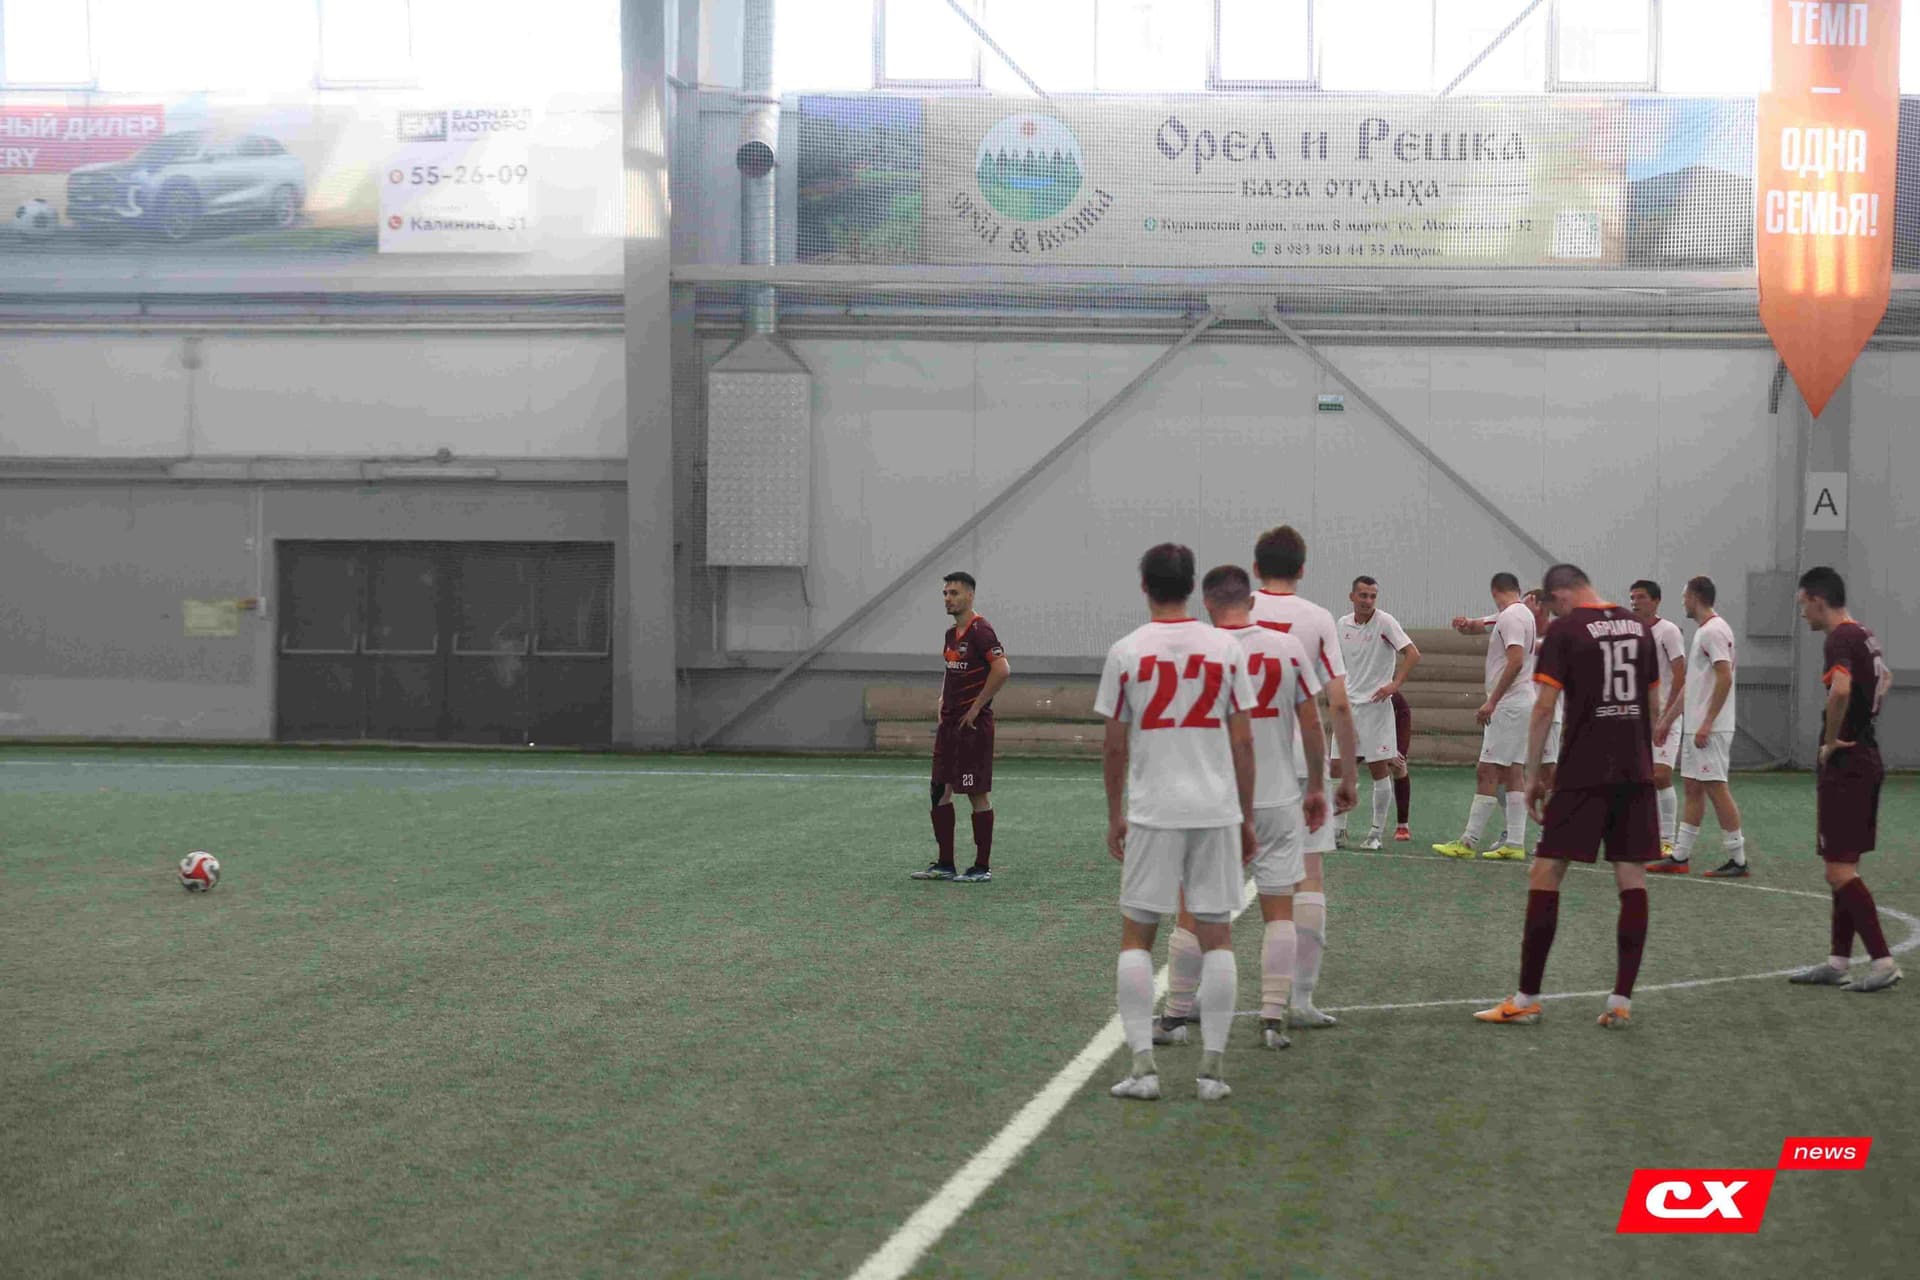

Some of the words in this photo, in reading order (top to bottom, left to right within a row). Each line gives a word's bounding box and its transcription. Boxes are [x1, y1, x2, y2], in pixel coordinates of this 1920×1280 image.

[1788, 1, 1868, 46] ТЕМП
[63, 116, 158, 141] ДИЛЕР
[410, 164, 529, 185] 55-26-09
[1781, 127, 1867, 179] ОДНА
[1333, 219, 1341, 231] 8
[1765, 189, 1880, 237] СЕМЬЯ!
[1137, 654, 1224, 730] 22
[1599, 638, 1639, 702] 15
[962, 773, 975, 787] 23
